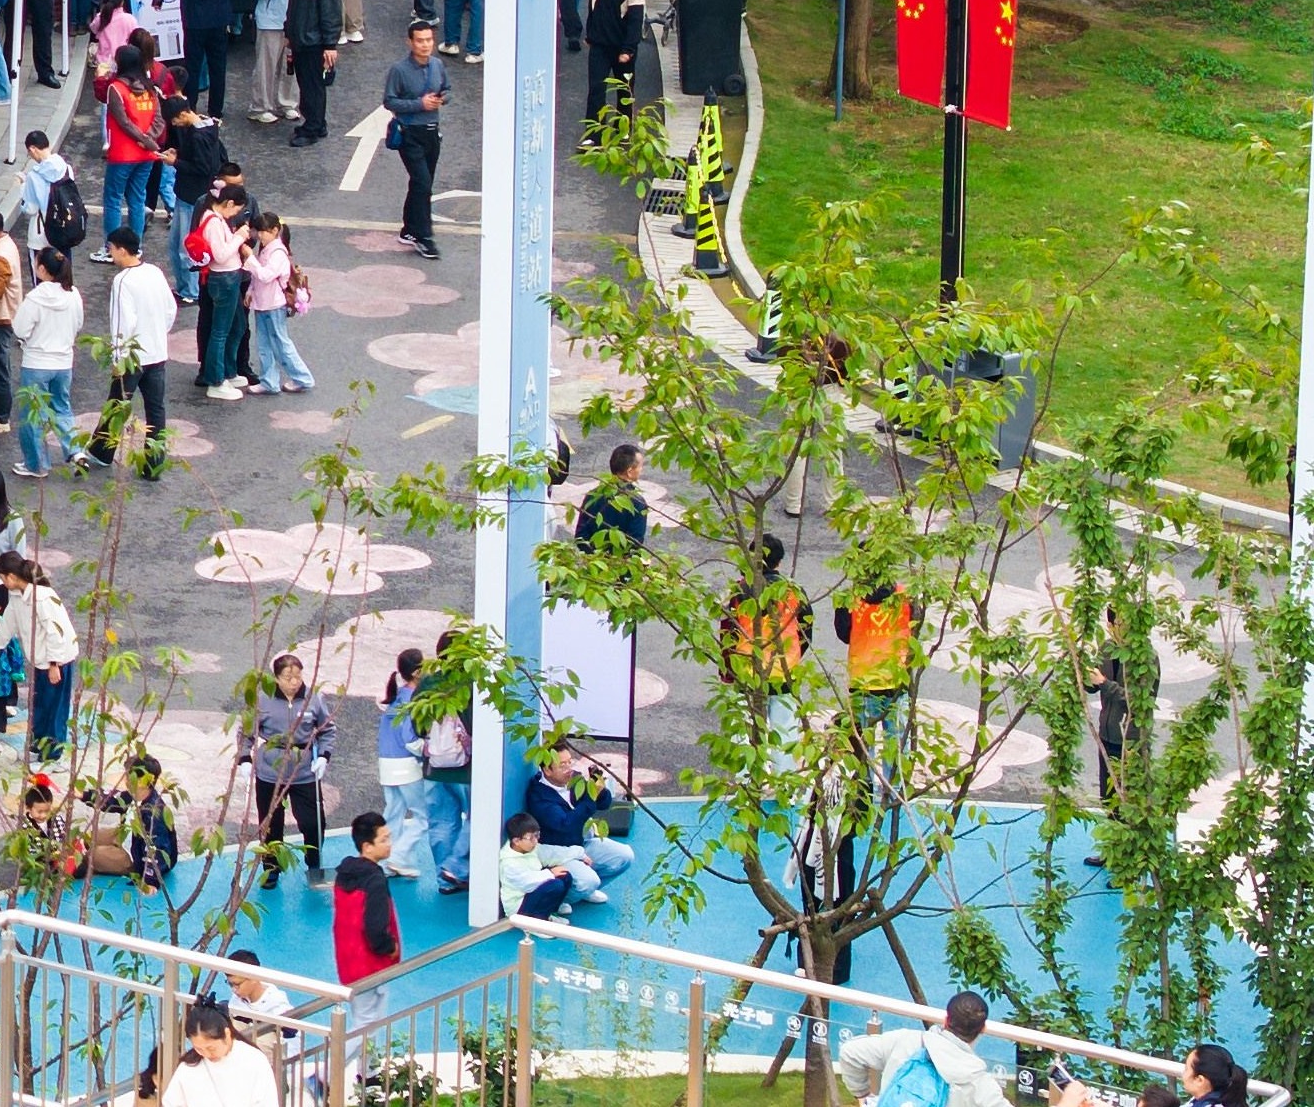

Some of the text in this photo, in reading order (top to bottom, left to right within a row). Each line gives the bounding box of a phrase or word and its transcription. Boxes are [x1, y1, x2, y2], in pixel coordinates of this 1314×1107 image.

[526, 69, 547, 292] 高新大道站
[523, 366, 537, 402] A
[553, 966, 603, 990] 光子咖
[723, 1002, 774, 1026] 光子咖
